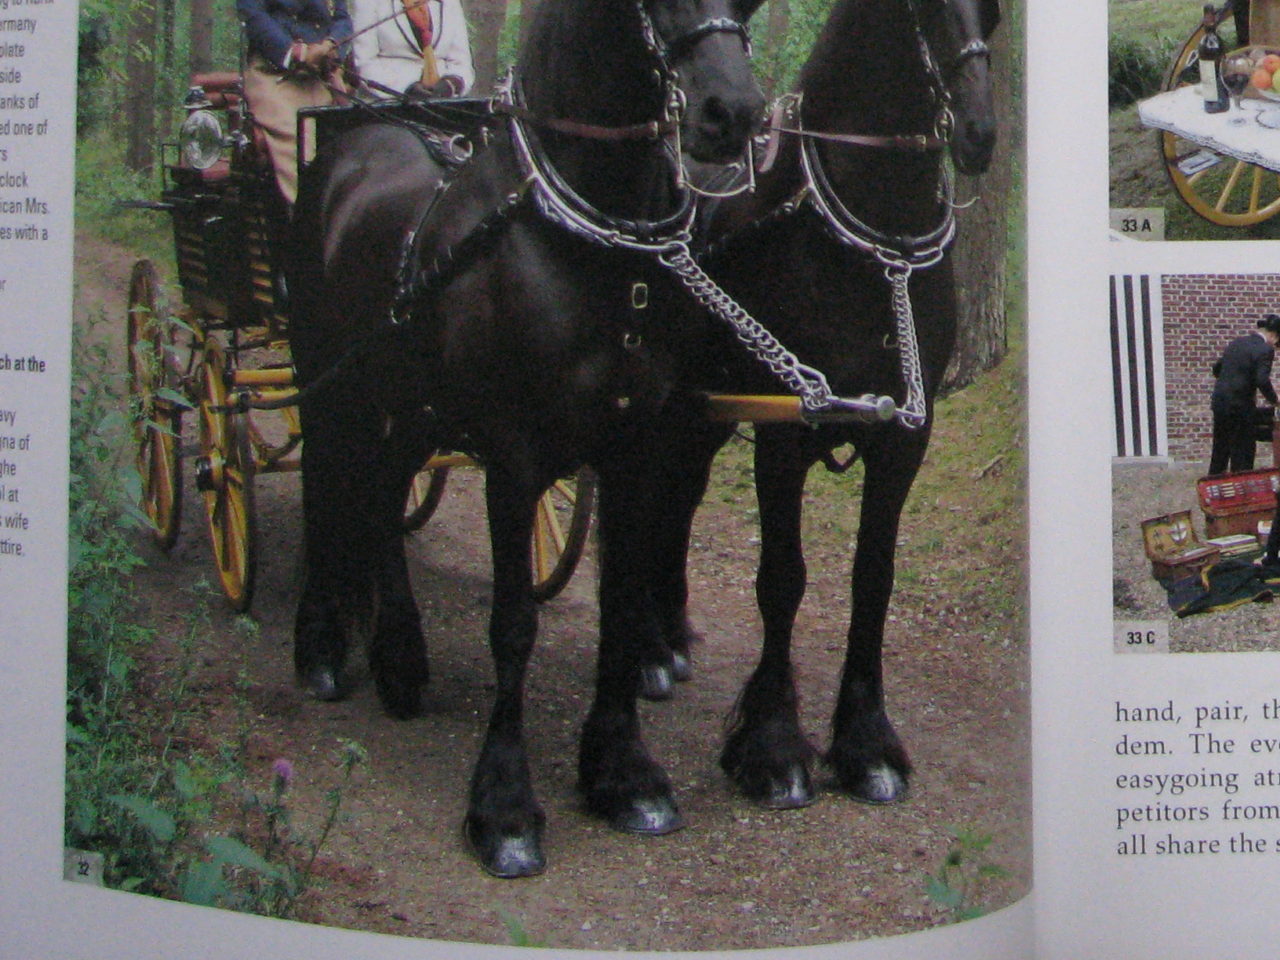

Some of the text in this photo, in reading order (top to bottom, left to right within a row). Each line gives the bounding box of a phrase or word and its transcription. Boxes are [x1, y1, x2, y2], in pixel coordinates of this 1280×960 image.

[28, 93, 39, 109] of
[13, 119, 48, 136] one of
[25, 198, 50, 214] Mrs.
[15, 224, 49, 241] with a
[1122, 219, 1151, 232] 33 A
[14, 355, 46, 373] at the
[19, 434, 30, 451] of
[8, 488, 19, 503] at
[5, 512, 29, 530] wife
[1127, 631, 1155, 644] 33 C
[1116, 700, 1181, 726] hand,
[1194, 699, 1249, 726] pair,
[1116, 733, 1173, 755] dem.
[1190, 732, 1234, 754] The
[1116, 767, 1239, 794] easygoing
[1117, 799, 1209, 827] petitors
[1222, 798, 1280, 819] from
[1117, 833, 1146, 855] all
[1156, 832, 1220, 854] share
[1230, 831, 1268, 853] the
